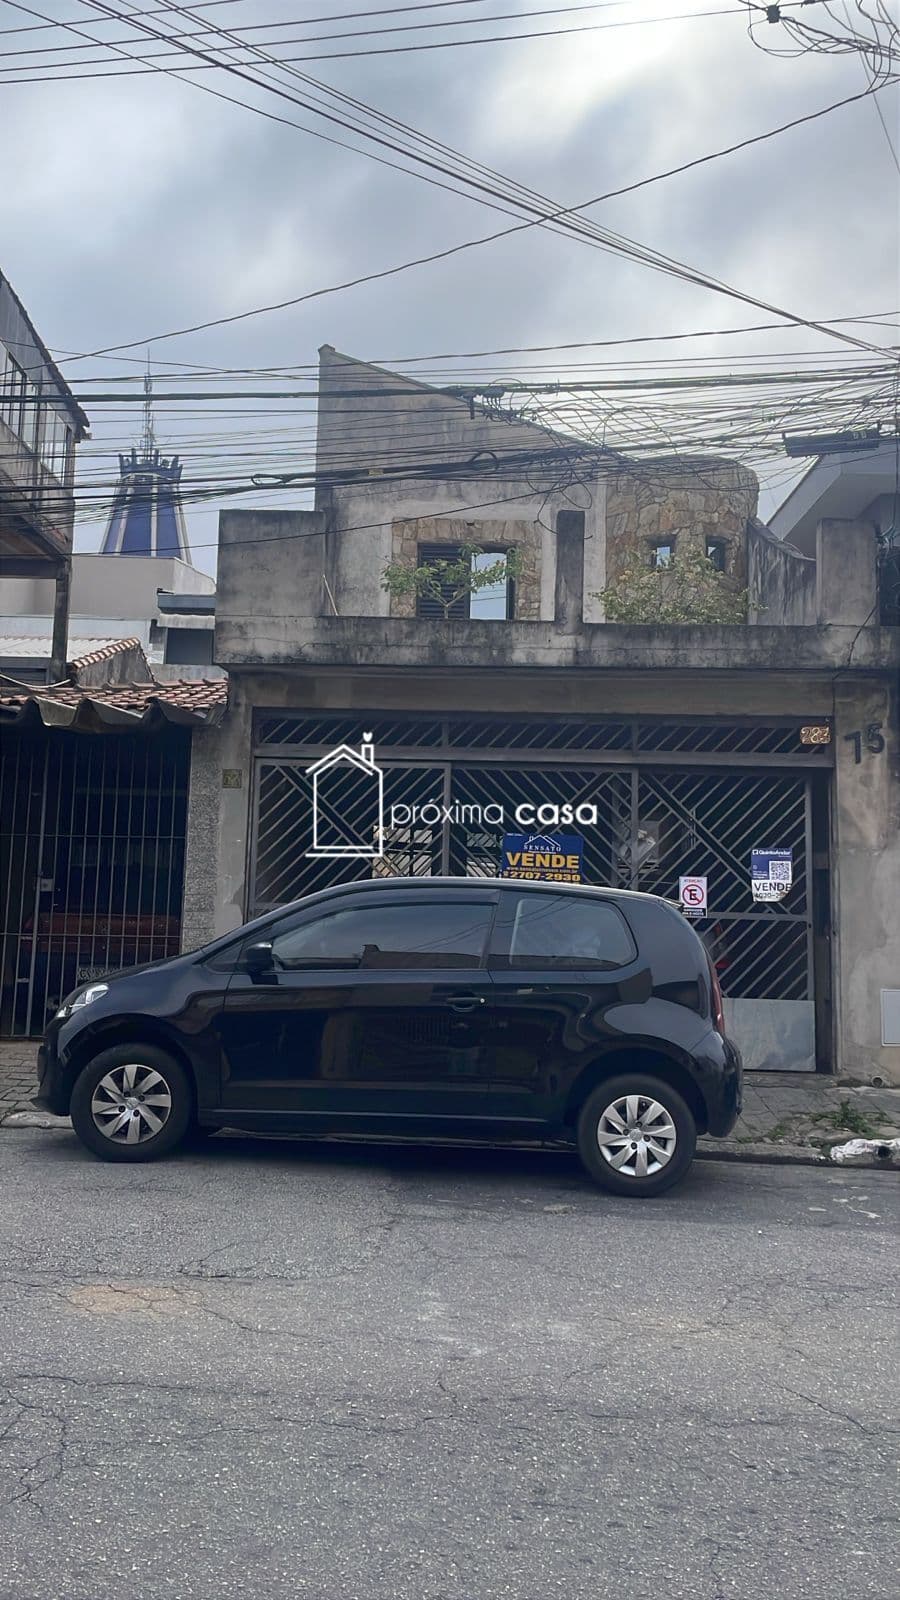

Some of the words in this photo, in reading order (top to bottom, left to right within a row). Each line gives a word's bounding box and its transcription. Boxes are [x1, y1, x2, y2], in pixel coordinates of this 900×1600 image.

[506, 852, 579, 869] VENDE
[510, 871, 581, 881] 2707-2930
[754, 882, 792, 891] VENDE
[689, 889, 697, 900] E
